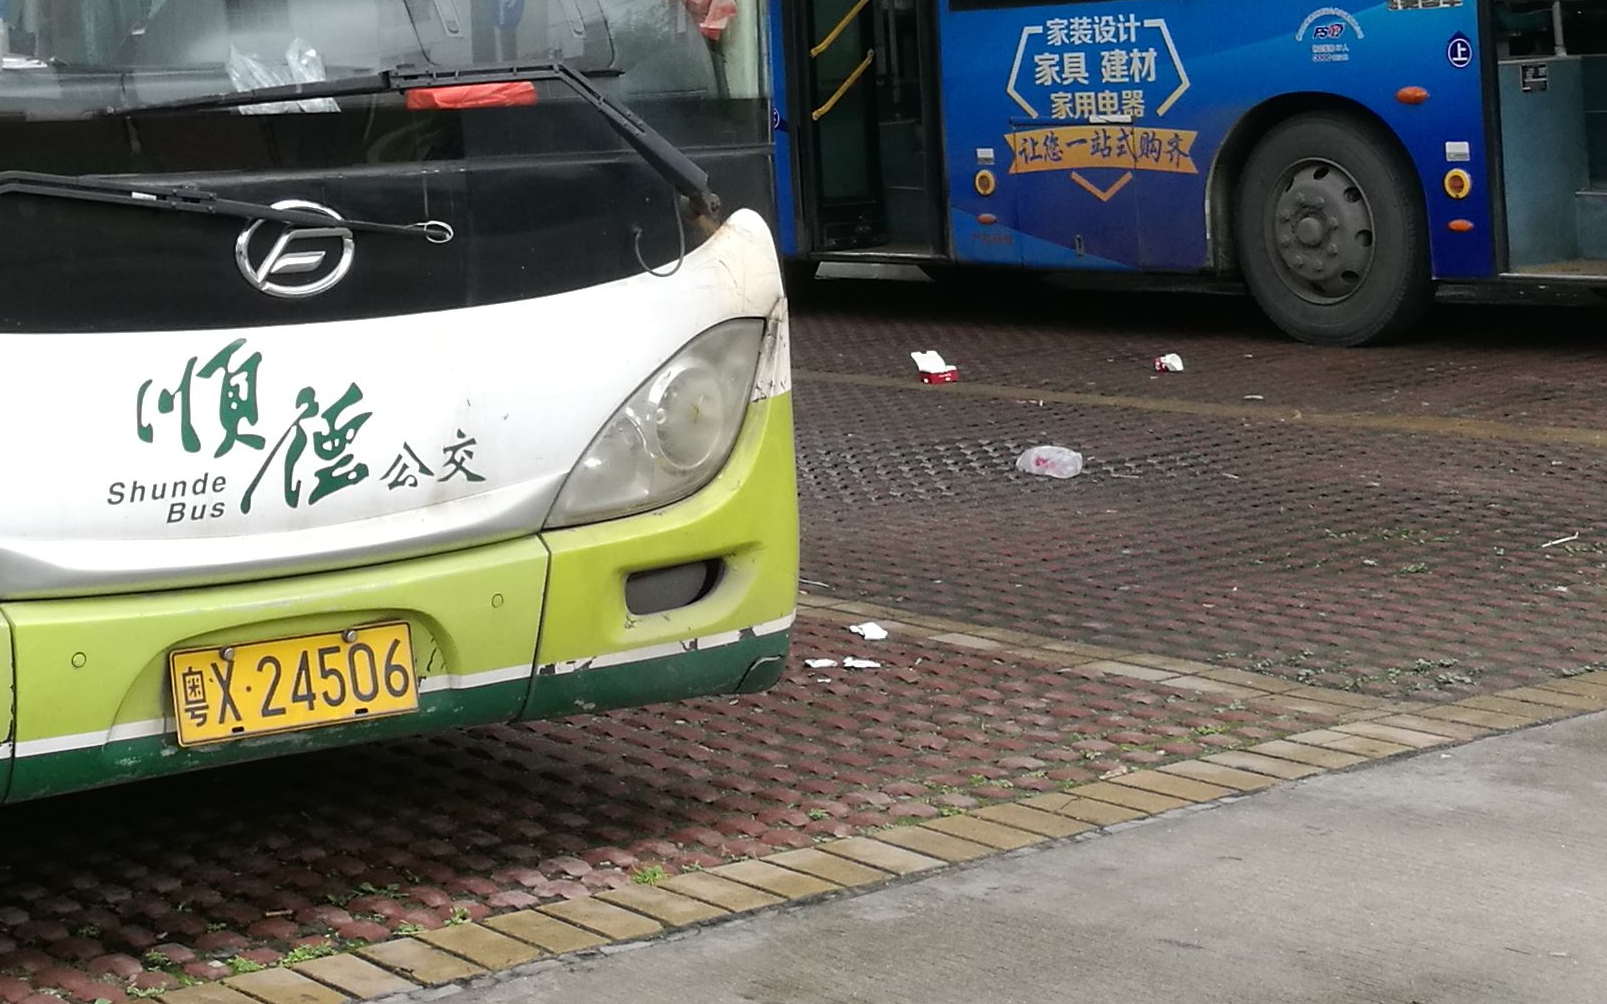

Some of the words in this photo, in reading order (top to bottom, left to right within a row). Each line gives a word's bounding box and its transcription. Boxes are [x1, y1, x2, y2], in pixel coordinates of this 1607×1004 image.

[1046, 13, 1141, 46] 家装设计
[1034, 52, 1089, 86] 家具
[1101, 48, 1157, 83] 建材
[1050, 89, 1145, 119] 家用电器
[1019, 130, 1191, 169] 让您一站式购齐
[380, 429, 486, 491] 公交
[107, 472, 227, 506] Shunde
[167, 502, 226, 525] Bus
